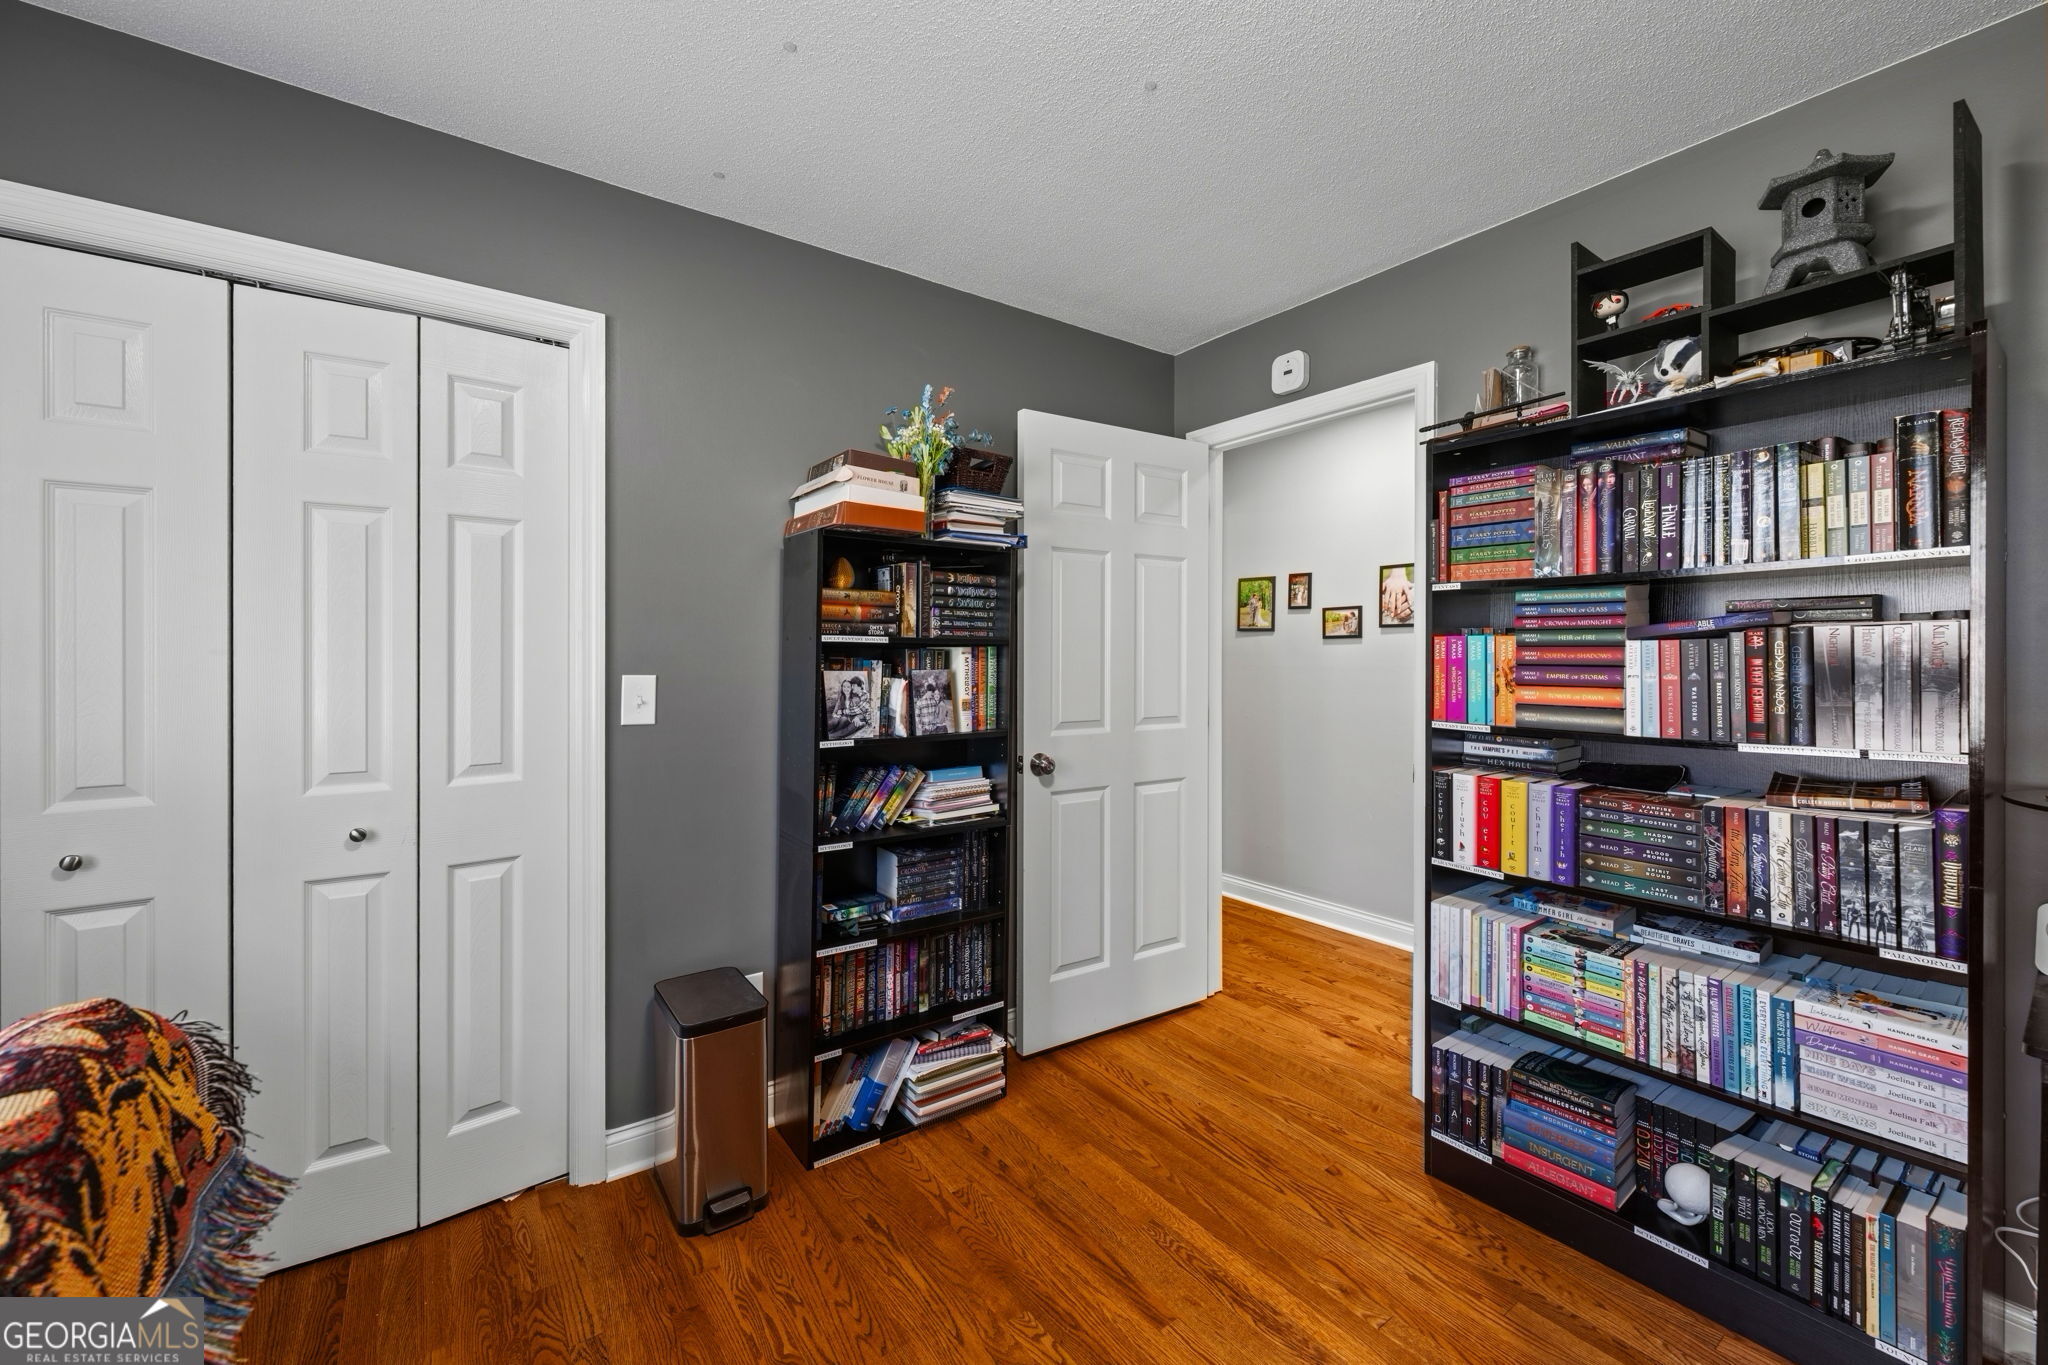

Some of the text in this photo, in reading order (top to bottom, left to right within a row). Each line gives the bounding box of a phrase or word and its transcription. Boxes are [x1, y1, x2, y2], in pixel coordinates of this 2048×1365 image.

[1606, 438, 1646, 449] VALIANT
[1948, 417, 1966, 477] REALMS LIGHT
[1907, 469, 1930, 528] NARNIA
[1623, 507, 1638, 541] CARAVAL
[1642, 499, 1657, 538] LEGENDARY
[1661, 504, 1677, 538] FINALE
[1932, 625, 1949, 639] KILL
[1775, 640, 1785, 715] BORN WICKED
[1792, 646, 1802, 710] STAR CURSED
[1509, 760, 1532, 769] HALL
[1638, 809, 1675, 817] ACADEMY
[1639, 819, 1678, 828] FROSTBITE
[1643, 832, 1673, 840] SHADOW
[1433, 859, 1503, 878] PARANORMAL ROMANCE
[1600, 861, 1619, 869] MEAD
[1705, 838, 1722, 879] Bloodlines
[1601, 879, 1620, 887] MEAD
[1941, 861, 1962, 908] DRACULA
[1641, 890, 1678, 900] SACRIFICE
[1517, 900, 1574, 920] THE SUMMER GIRL
[1640, 928, 1695, 948] BEAUTIFUL GRAVES
[1883, 950, 1966, 971] PARANORMAL
[1725, 987, 1733, 1012] COLLEEN
[1743, 997, 1751, 1020] STARTS
[1711, 1013, 1720, 1037] PERFECTS
[1743, 1021, 1752, 1037] WITH
[1759, 1001, 1767, 1044] EVERYTHING
[1776, 1009, 1786, 1055] ARCHER'S VOICE
[1744, 1038, 1752, 1047] US
[1805, 1021, 1940, 1061] Wildfire HANNAH GRACE
[1887, 1027, 1938, 1044] HANNAH GRACE
[1805, 1036, 1943, 1078] Daydream HANNAH GRACE
[1805, 1049, 1936, 1092] NINE DAYS Joelina Falk
[1544, 1095, 1591, 1116] HUNGER GAMES
[1888, 1089, 1937, 1109] Joelina Falk
[1543, 1115, 1587, 1137] MOCKINGJAY
[1832, 1108, 1937, 1149] YEARS Joelina Falk
[1888, 1108, 1938, 1129] Joelina Falk
[1528, 1142, 1596, 1177] INSURGENT
[1797, 1152, 1819, 1162] STOHL
[1528, 1162, 1597, 1198] ALLEGIANT
[1790, 1213, 1802, 1260] OUT OF OZ
[1832, 1209, 1841, 1256] FRANKENSTEIN
[1814, 1240, 1823, 1296] GREGORY MAGUIRE
